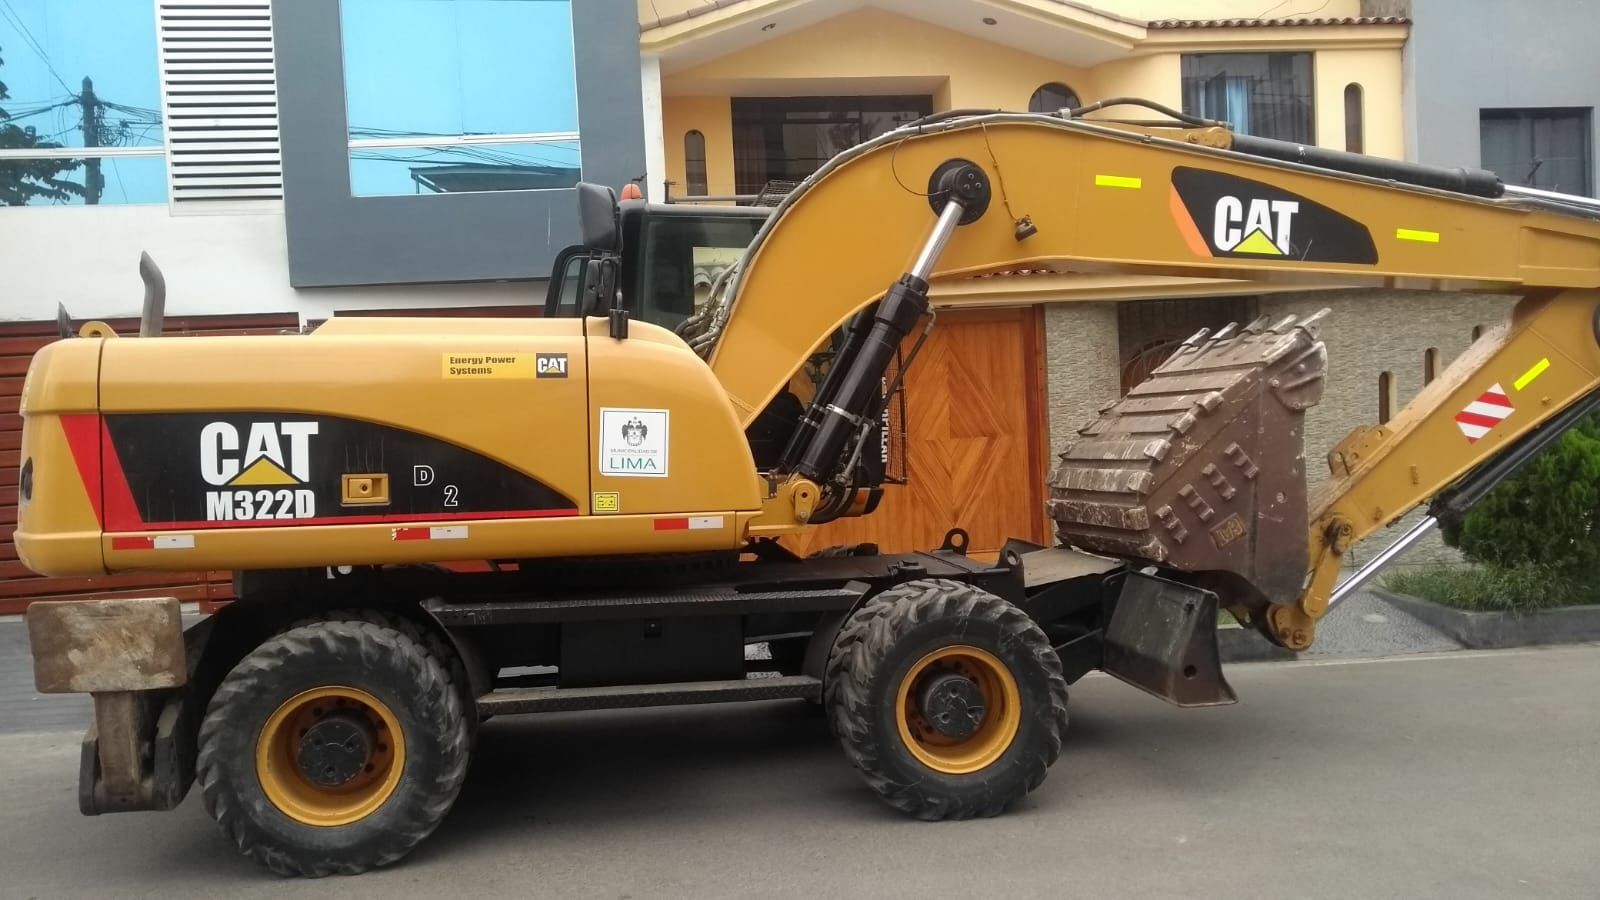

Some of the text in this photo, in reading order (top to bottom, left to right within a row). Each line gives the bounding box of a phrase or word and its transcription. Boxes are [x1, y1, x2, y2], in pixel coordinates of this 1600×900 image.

[1213, 195, 1300, 256] CAT
[449, 356, 516, 365] Energy Power
[449, 366, 493, 376] Systems
[537, 357, 568, 374] CAT
[199, 420, 320, 487] CAT
[610, 457, 657, 470] LIMA
[413, 464, 435, 487] D
[206, 488, 316, 521] M322D
[444, 484, 459, 507] 2
